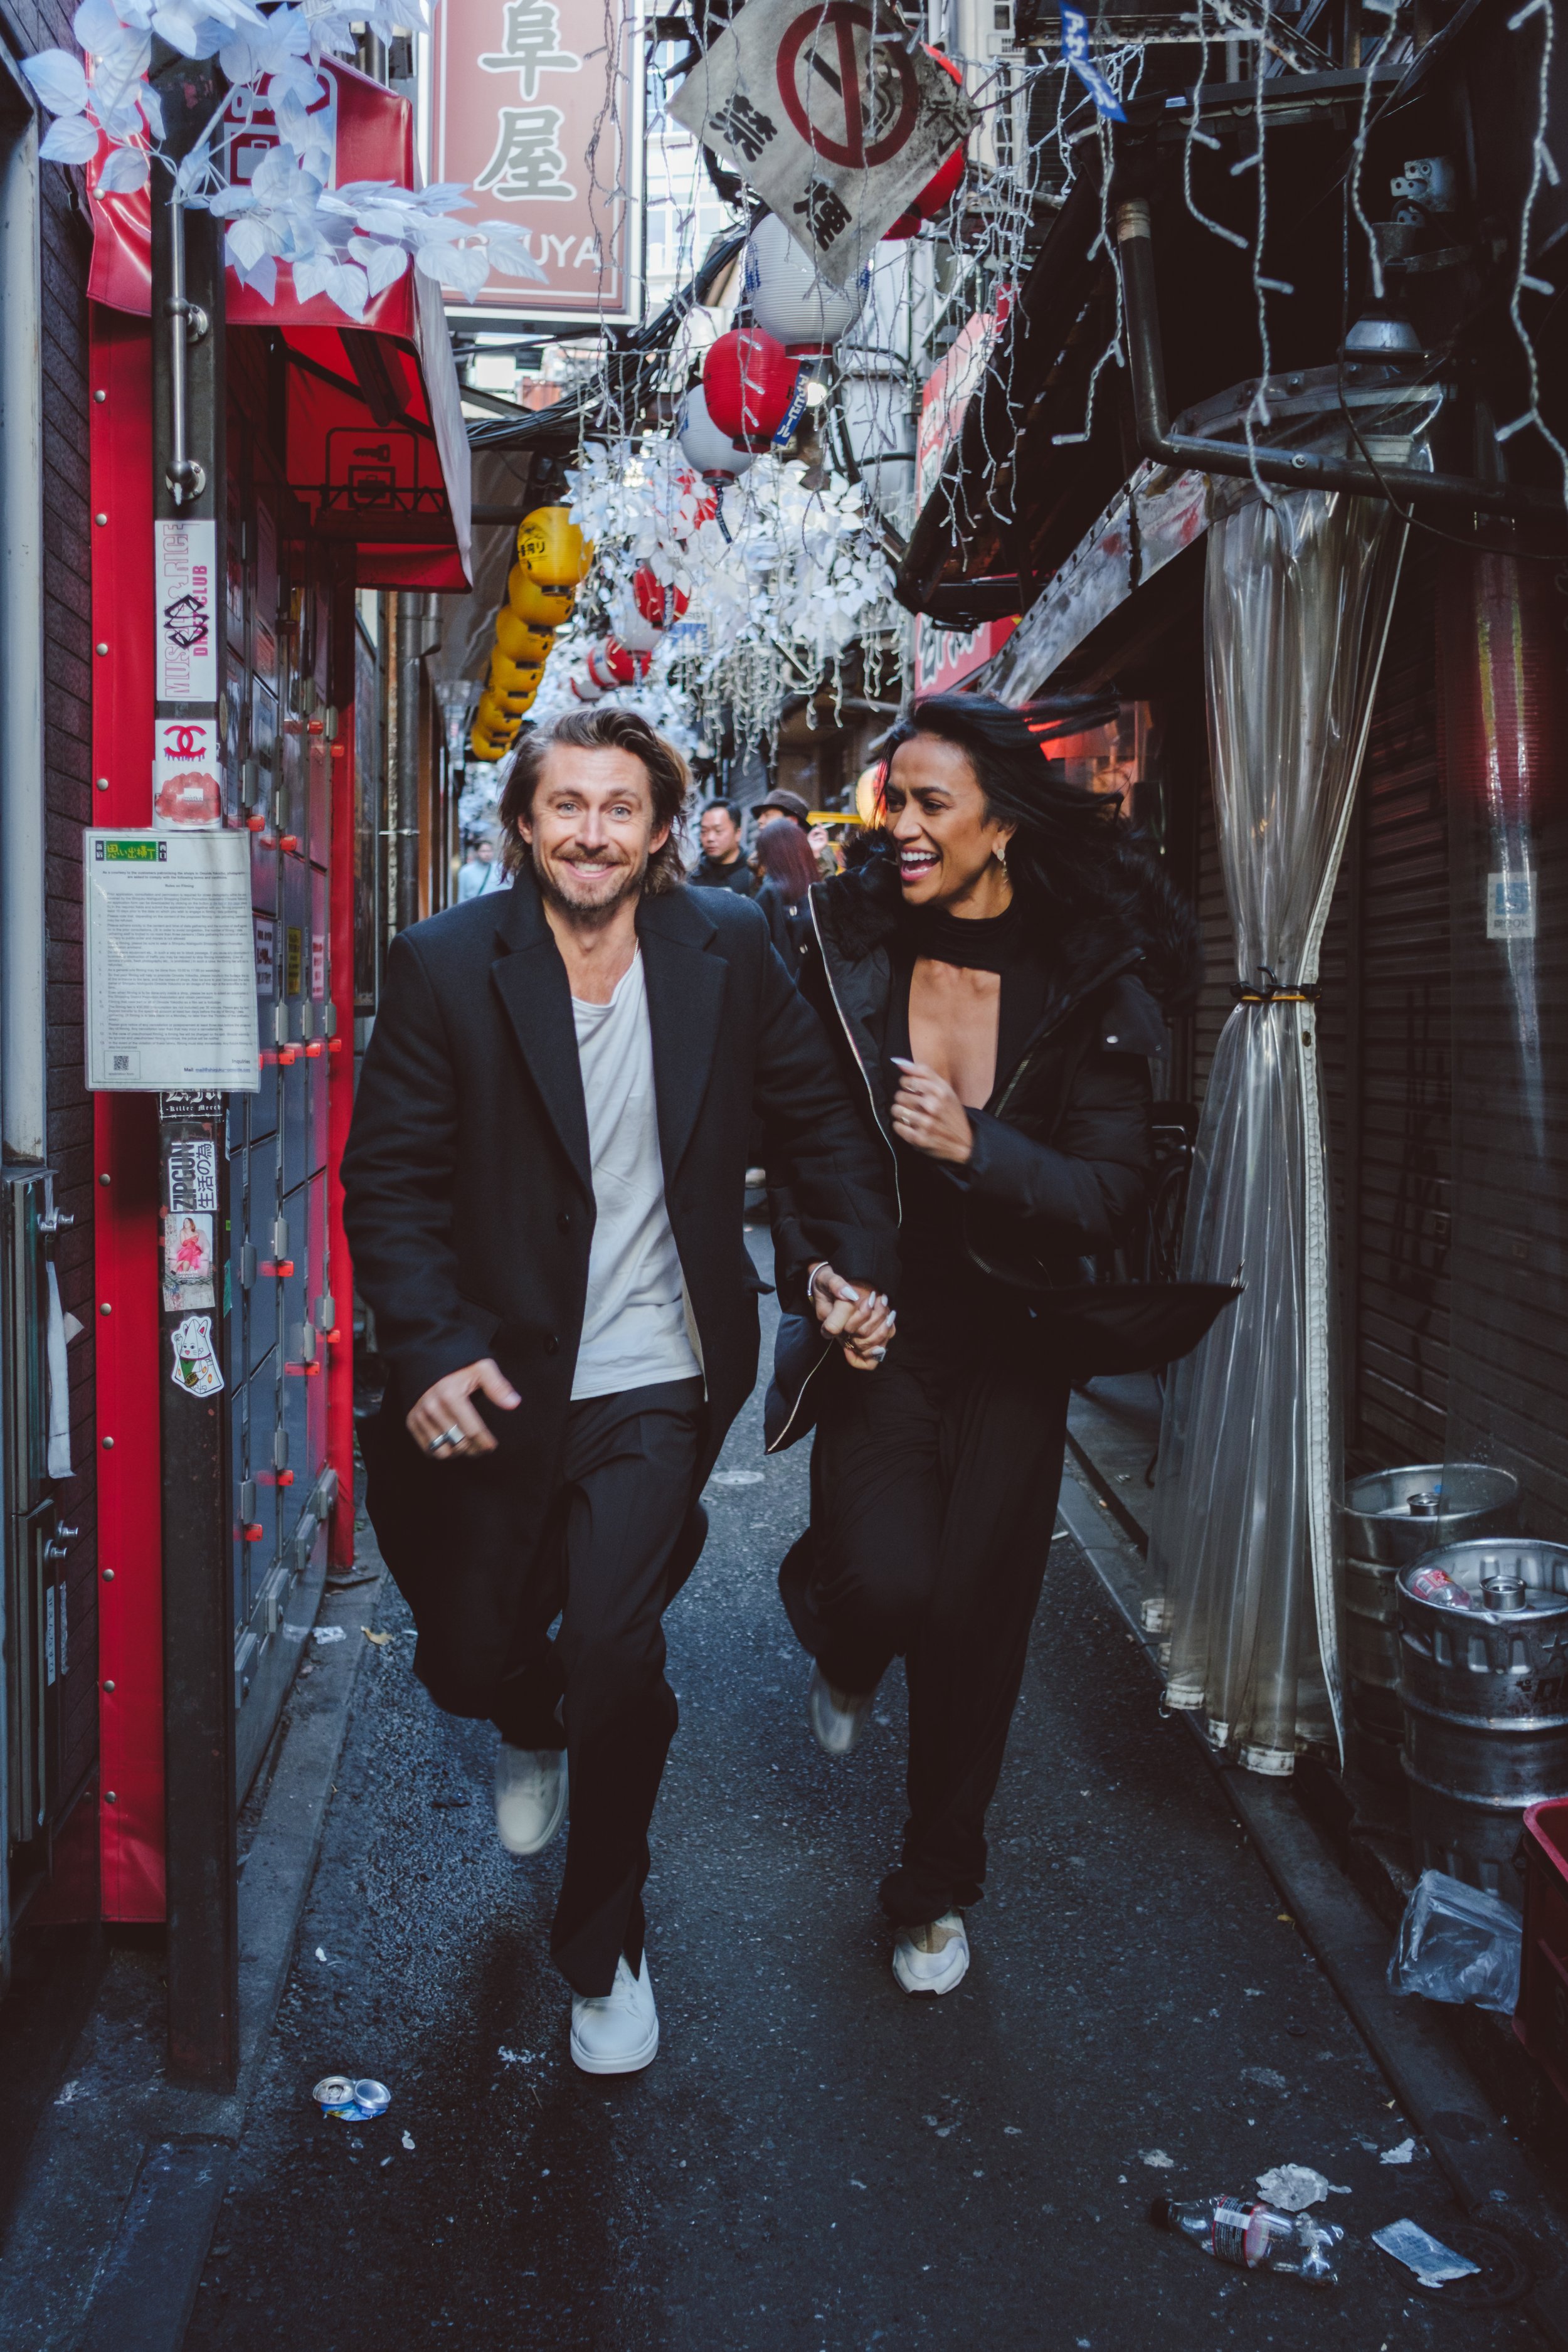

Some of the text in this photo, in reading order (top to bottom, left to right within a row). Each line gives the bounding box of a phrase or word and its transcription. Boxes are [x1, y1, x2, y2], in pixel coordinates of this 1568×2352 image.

[193, 566, 208, 607] CLUB
[107, 844, 156, 860] 思い出横丁
[170, 1144, 198, 1210] ZIPGUN
[196, 1143, 215, 1209] 生活の為
